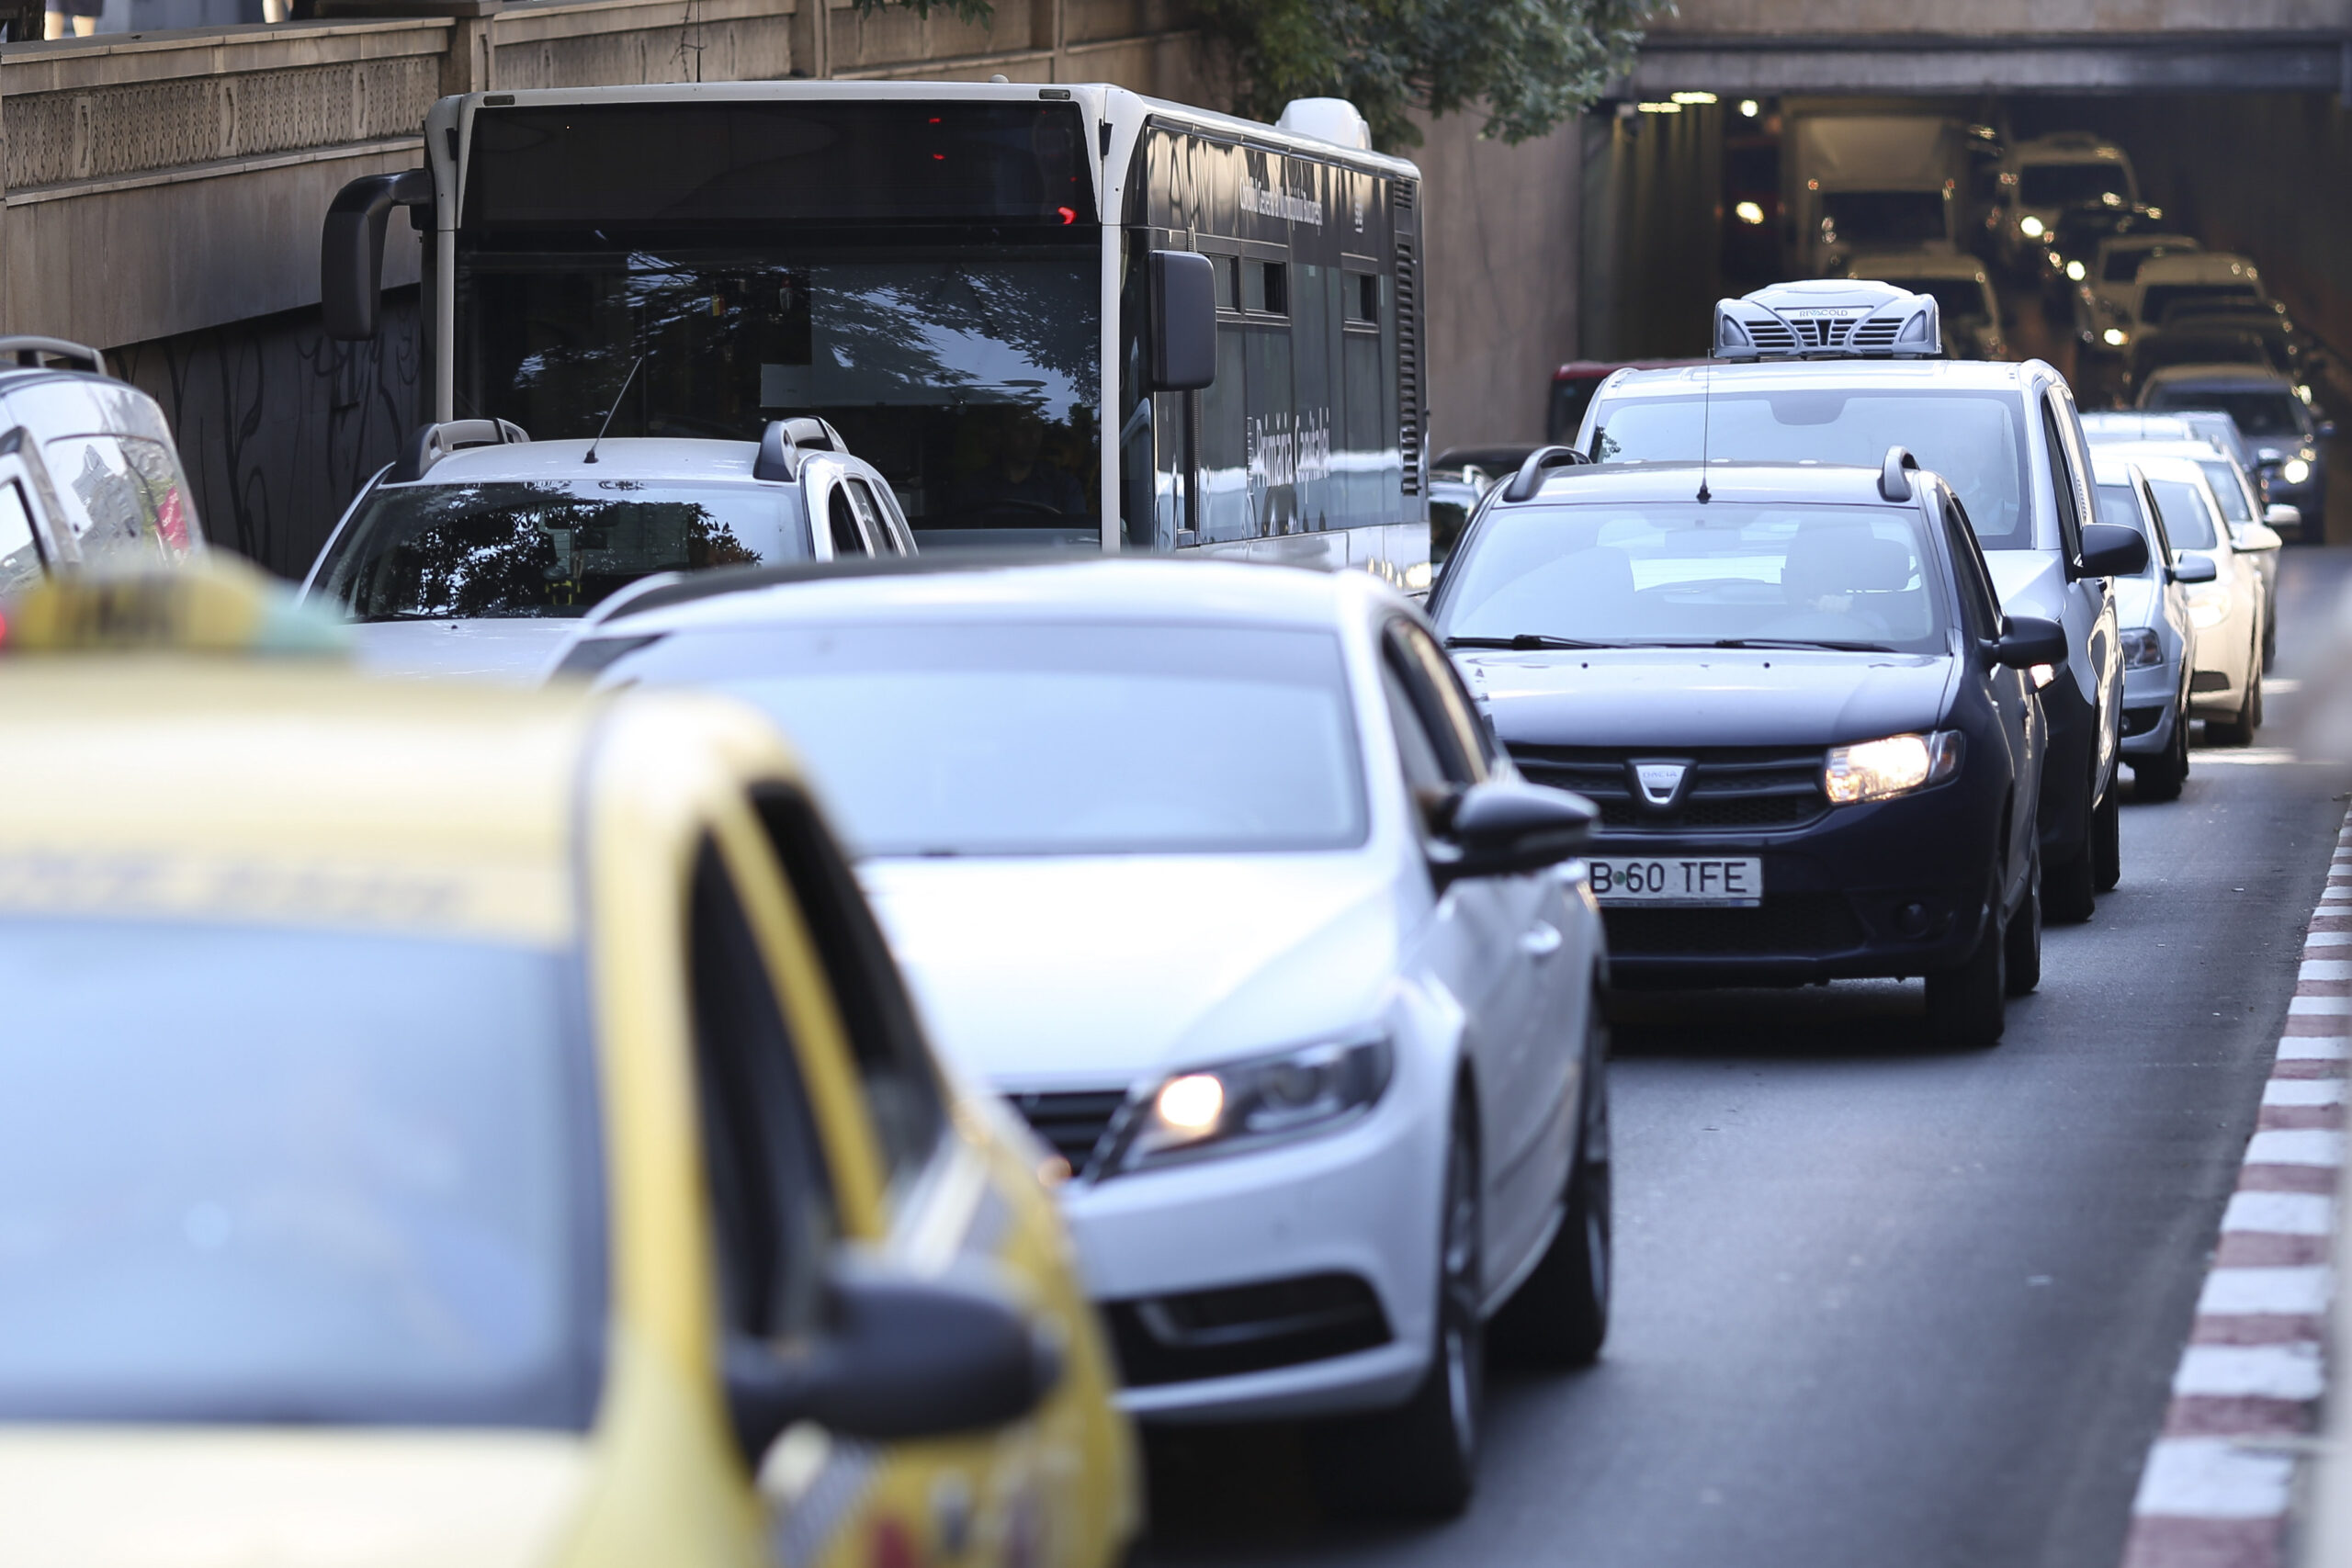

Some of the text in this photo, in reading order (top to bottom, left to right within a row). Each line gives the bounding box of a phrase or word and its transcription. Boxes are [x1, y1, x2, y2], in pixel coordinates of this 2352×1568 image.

[1799, 309, 1849, 318] RIVACOLD
[1256, 407, 1330, 504] Primăria Capitalei
[1589, 862, 1747, 894] B 60 TFE
